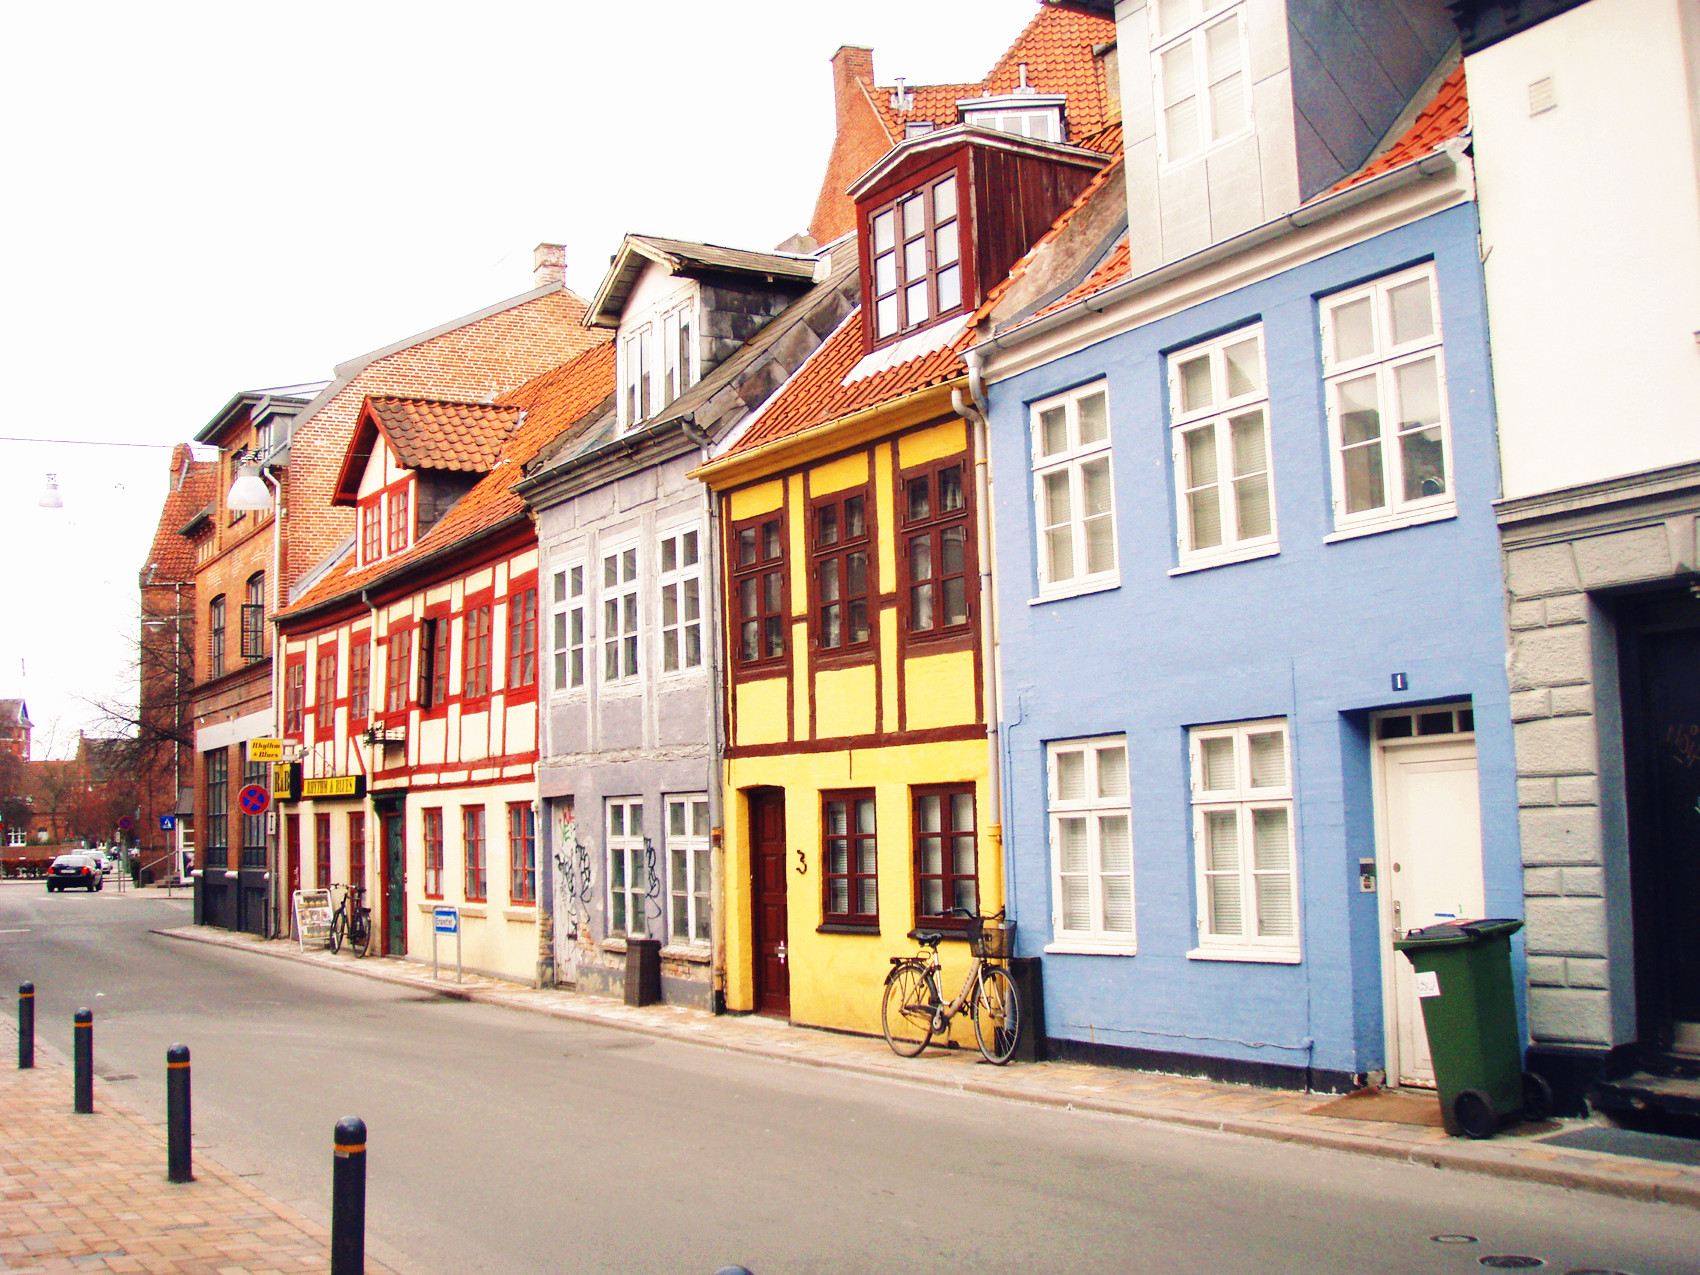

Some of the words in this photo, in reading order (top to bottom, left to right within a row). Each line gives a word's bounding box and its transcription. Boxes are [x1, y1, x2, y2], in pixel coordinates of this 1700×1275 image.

[1396, 674, 1402, 689] 1
[252, 742, 281, 750] Rhythm
[274, 770, 290, 793] R&B
[306, 780, 328, 794] RHYTHM
[335, 778, 353, 793] BLUES
[796, 849, 807, 875] 3
